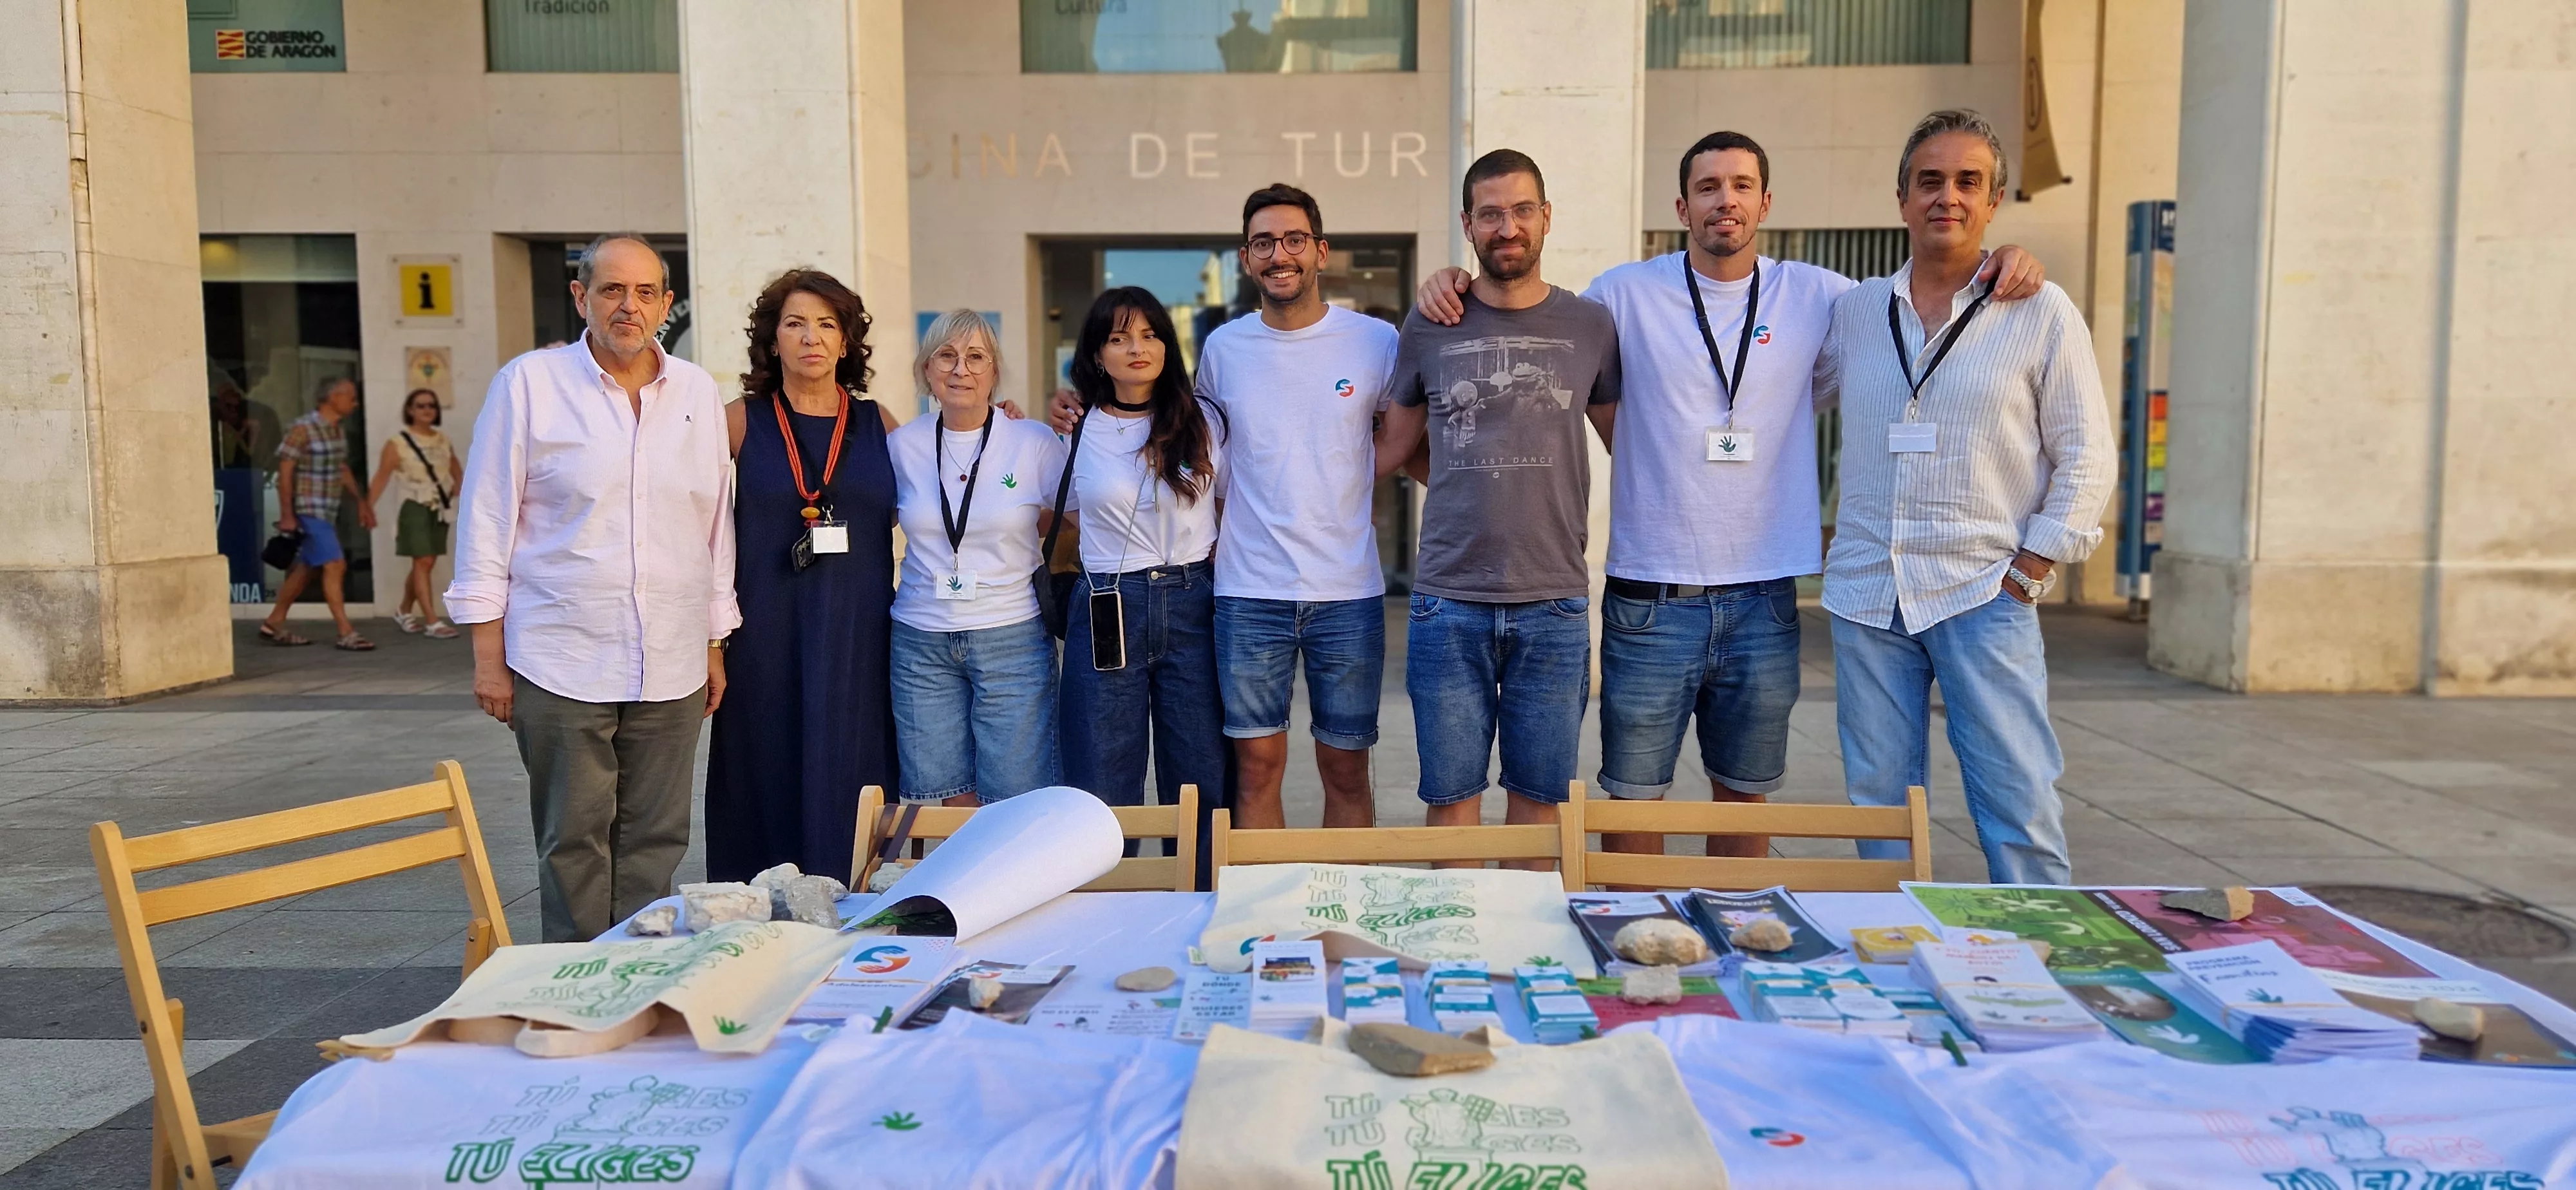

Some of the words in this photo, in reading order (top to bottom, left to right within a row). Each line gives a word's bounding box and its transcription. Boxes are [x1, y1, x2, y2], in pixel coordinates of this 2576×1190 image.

[245, 30, 324, 43] GOBIERNO
[245, 45, 267, 57] DE
[1130, 132, 1220, 179] DE
[1473, 457, 1504, 466] LAST
[444, 1137, 516, 1183] TÚ
[518, 1143, 701, 1183] ELIGES
